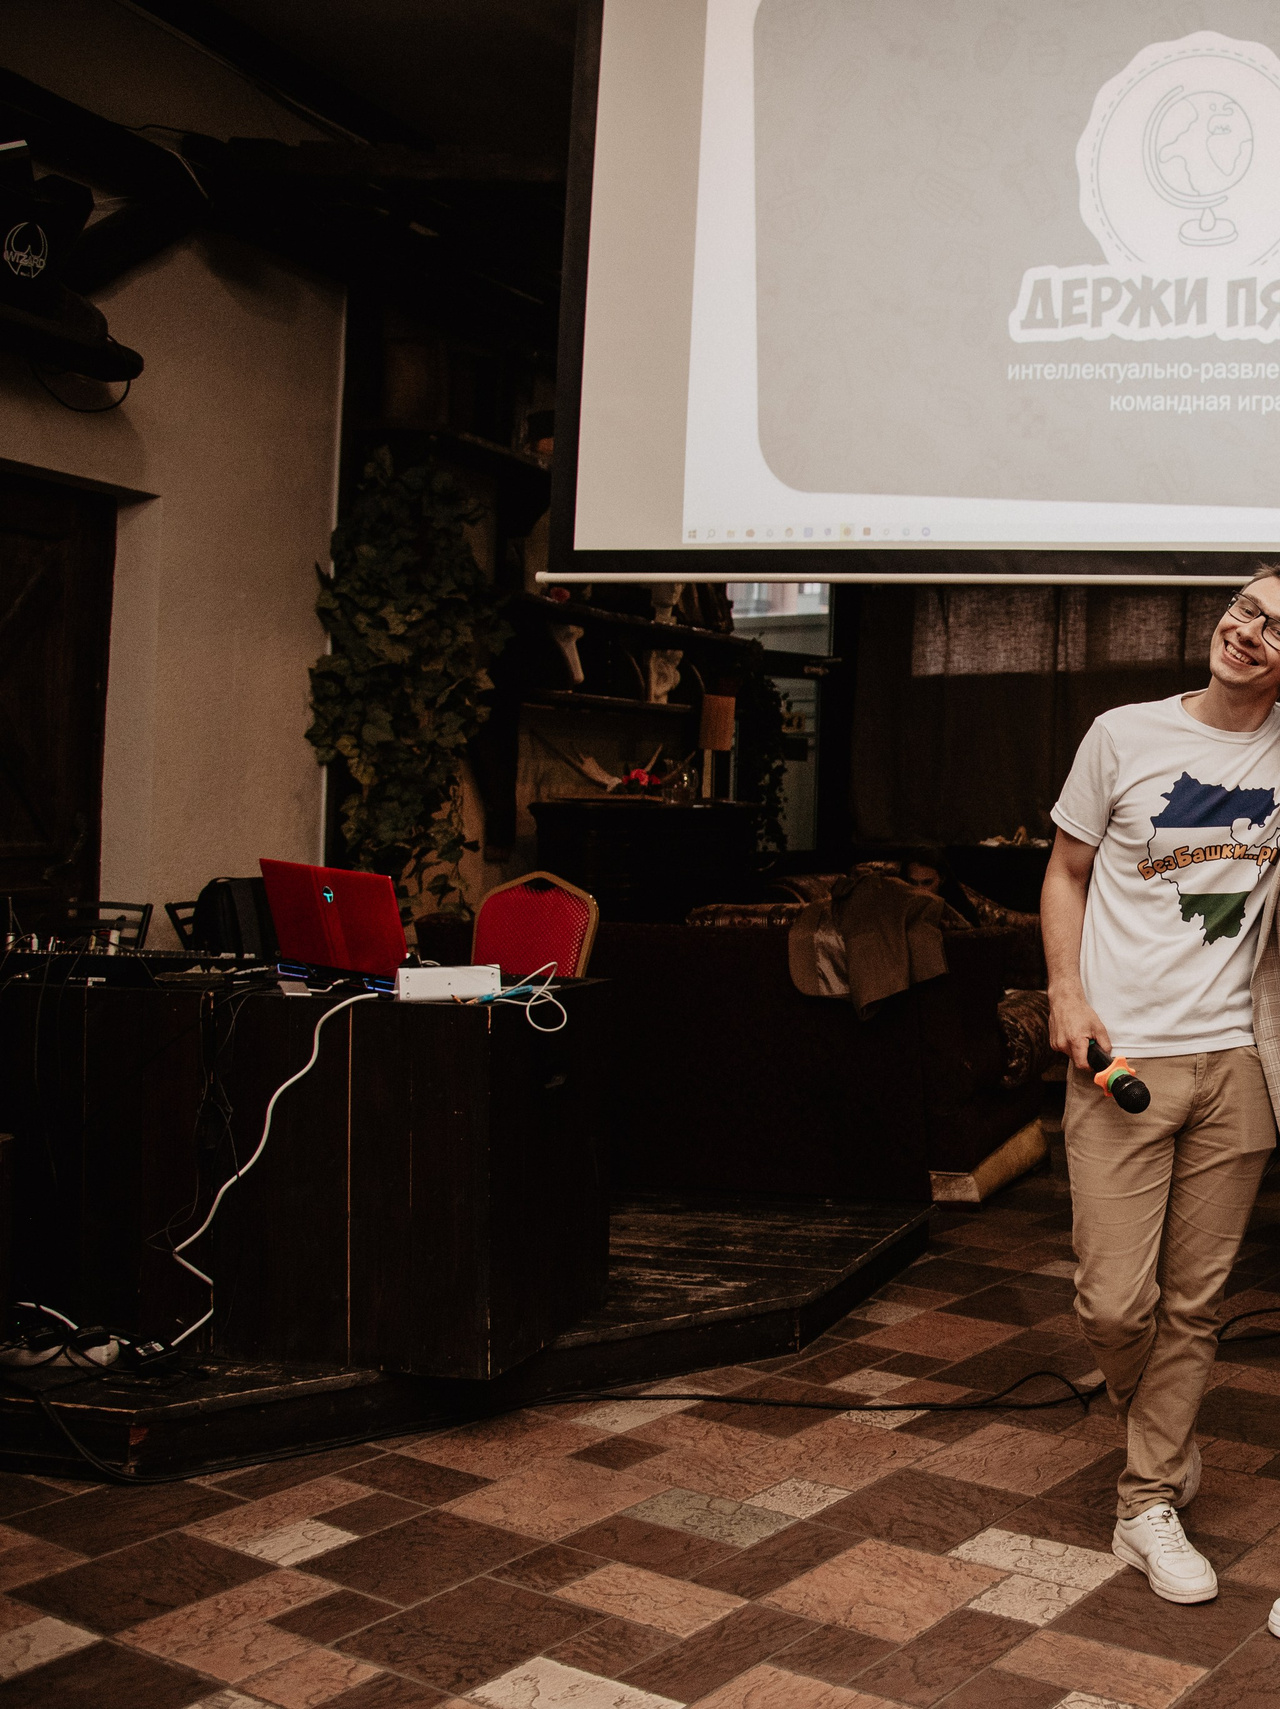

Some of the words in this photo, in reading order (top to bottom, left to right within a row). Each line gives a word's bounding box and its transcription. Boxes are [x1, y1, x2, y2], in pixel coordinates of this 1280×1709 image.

[4, 251, 46, 269] WIZARD
[1019, 274, 1209, 331] ДЕРЖИ
[1109, 393, 1231, 414] командная
